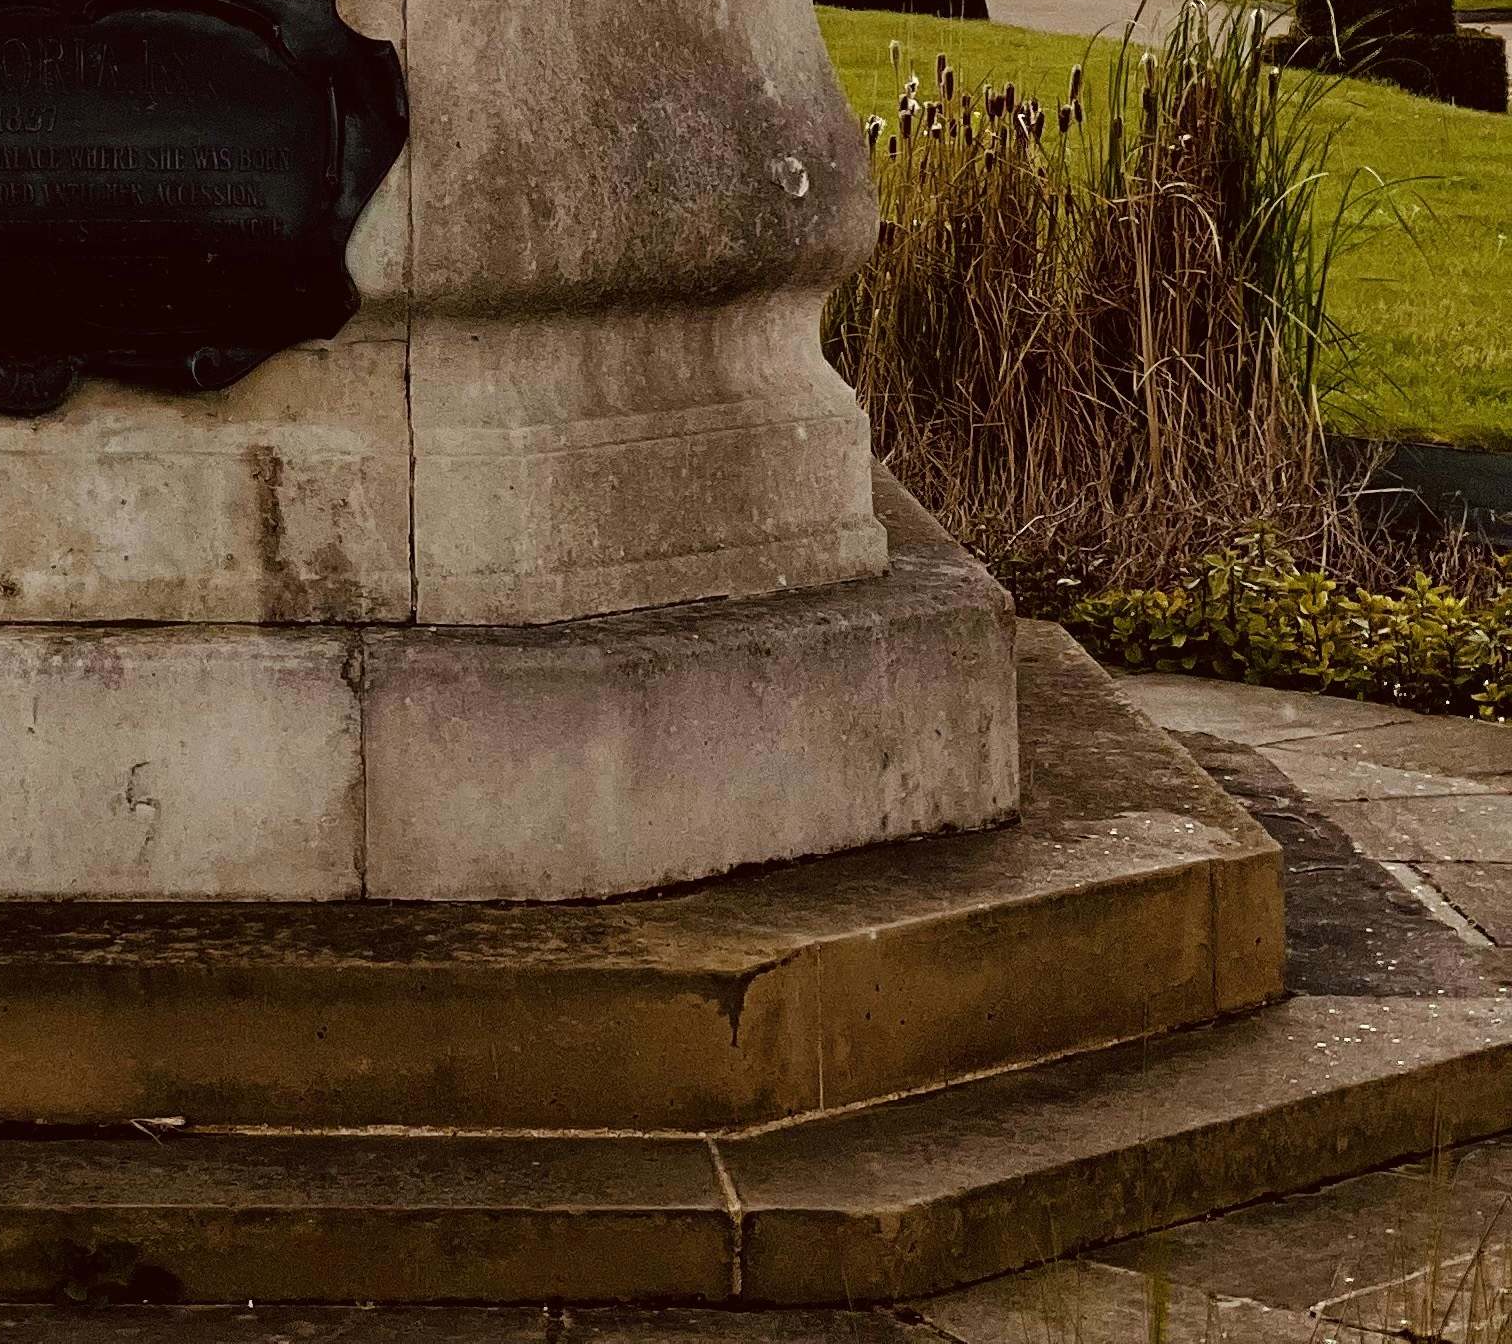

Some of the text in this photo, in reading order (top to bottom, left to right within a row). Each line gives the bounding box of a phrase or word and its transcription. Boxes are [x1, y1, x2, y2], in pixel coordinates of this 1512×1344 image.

[69, 145, 138, 171] WHERE
[146, 145, 185, 171] SHE
[192, 145, 232, 171] WAS
